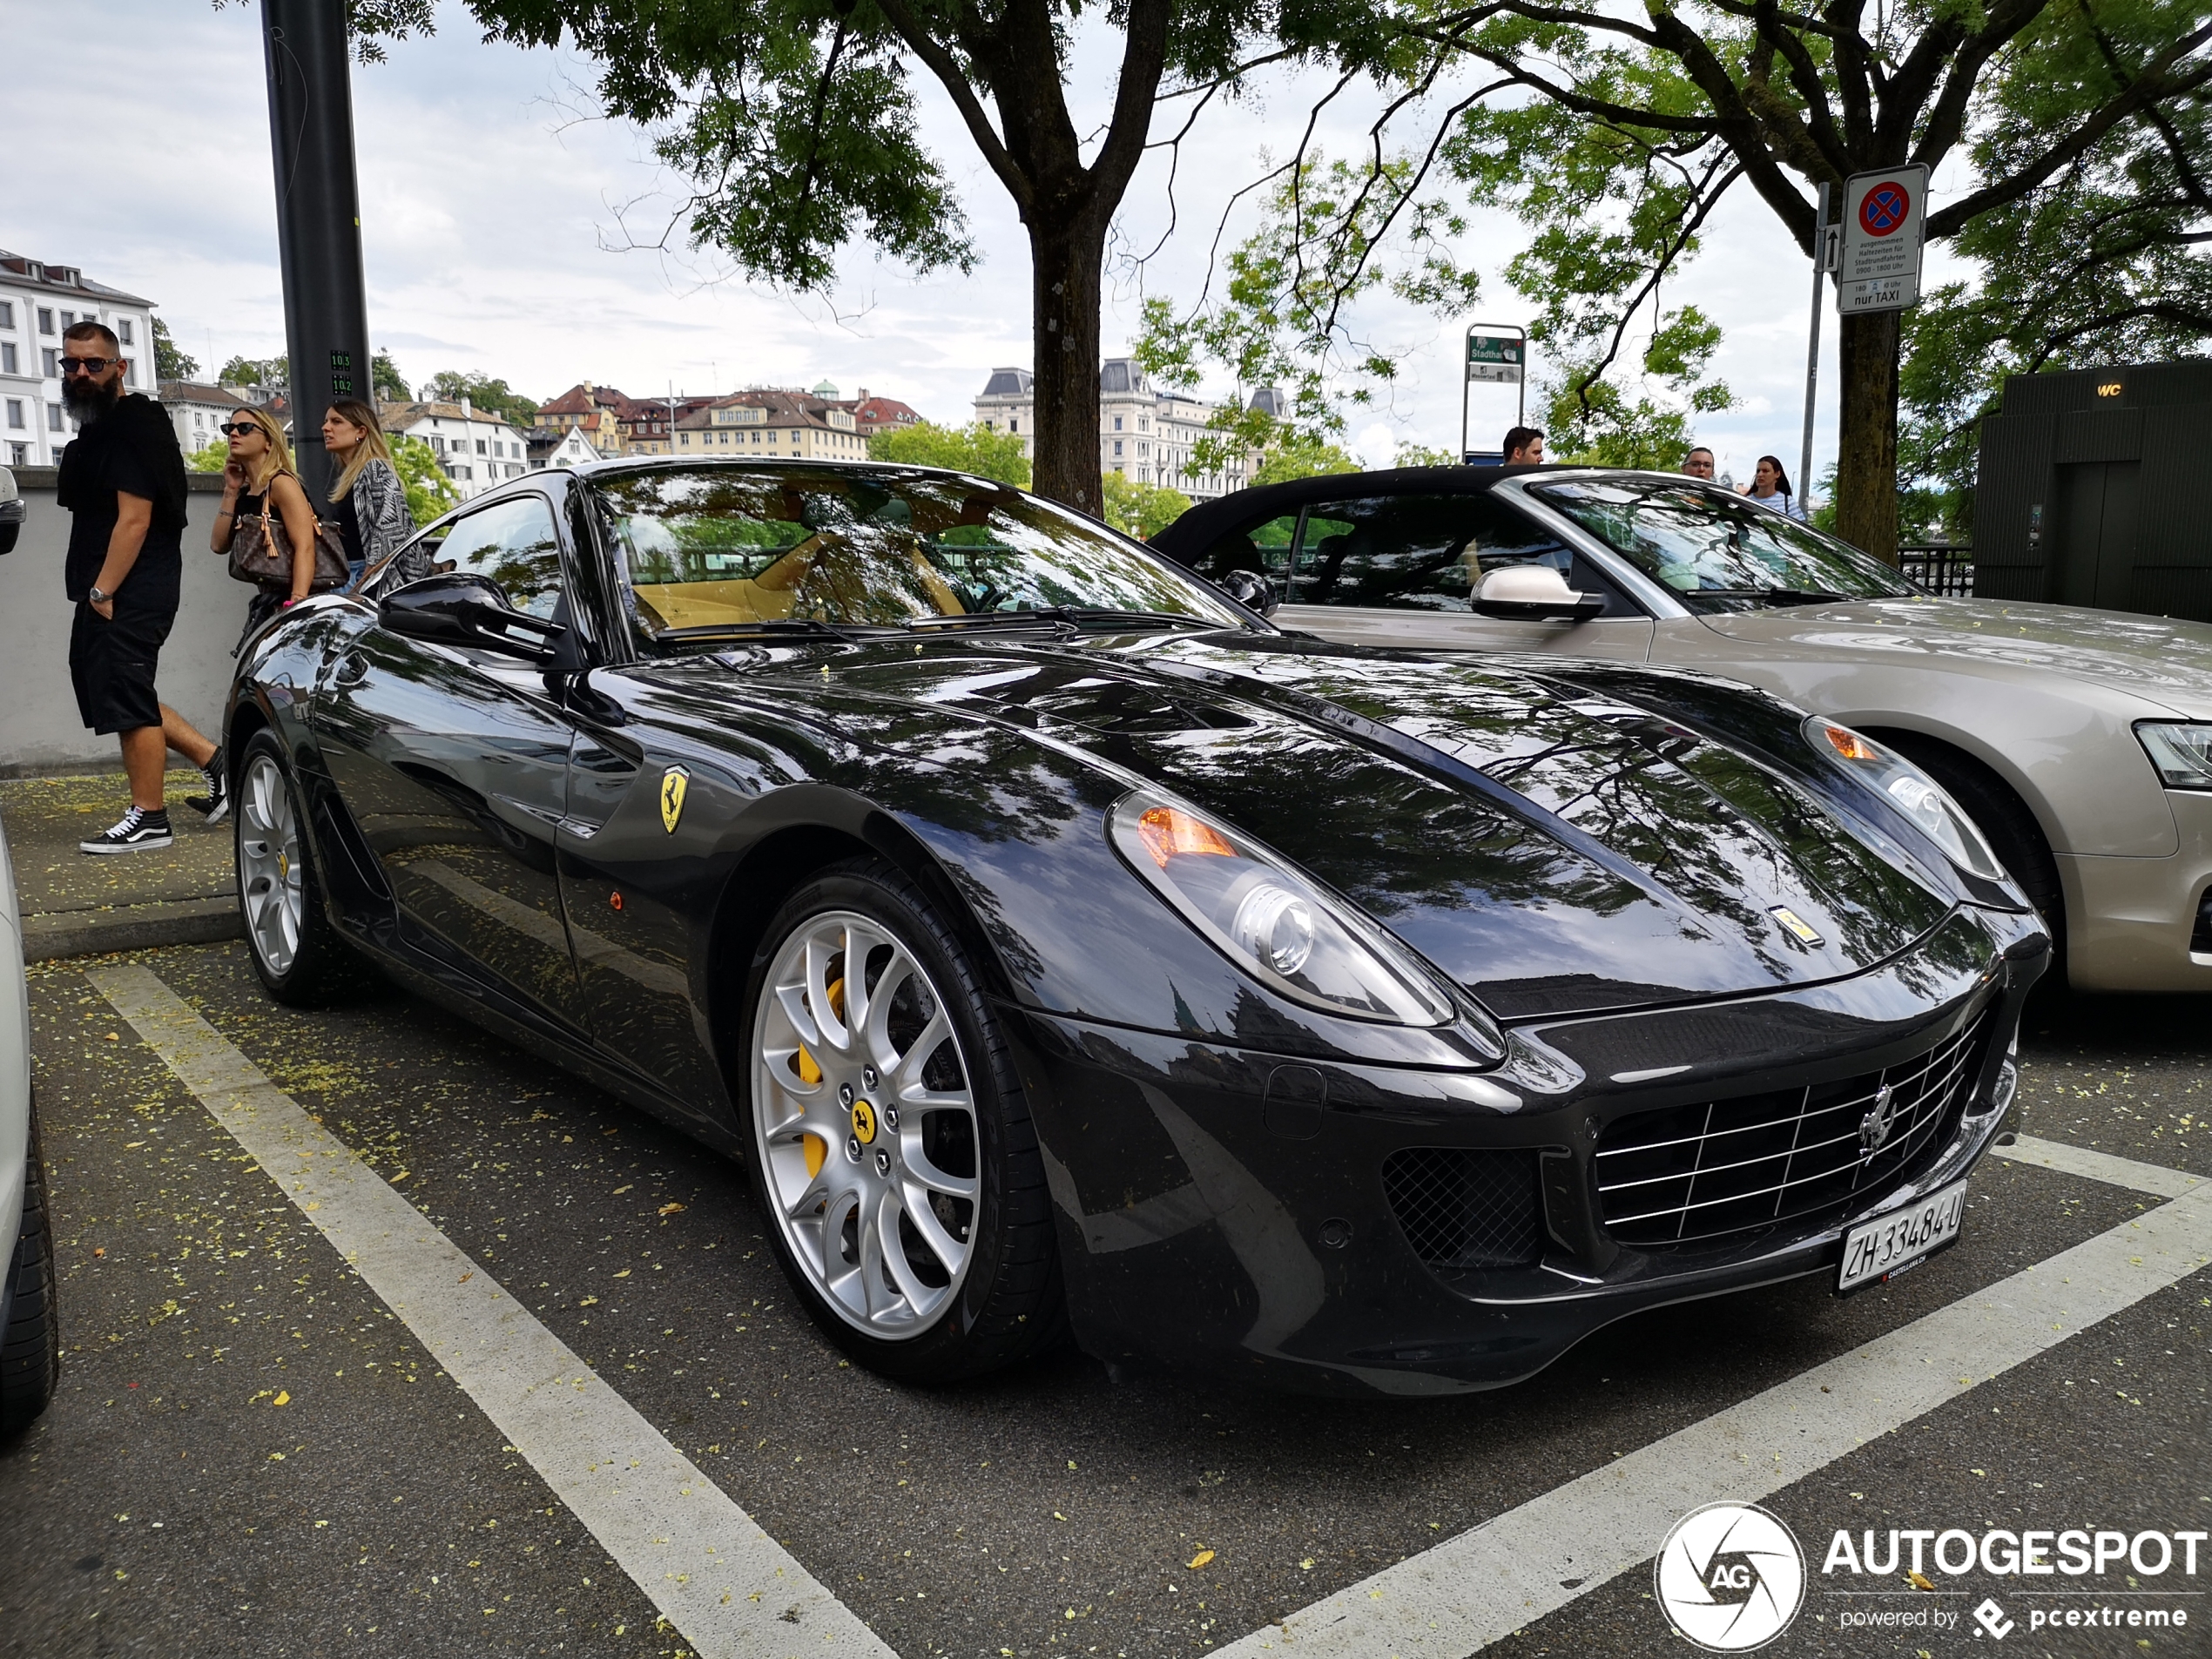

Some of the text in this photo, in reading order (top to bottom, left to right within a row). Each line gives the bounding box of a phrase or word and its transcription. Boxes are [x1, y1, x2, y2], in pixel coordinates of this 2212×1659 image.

[1860, 237, 1904, 248] ausgenommen
[1858, 246, 1892, 257] Haltezeiten
[1855, 254, 1906, 266] Stadtrundfahrten
[1855, 289, 1899, 306] nur TAXI
[2097, 384, 2121, 397] WC
